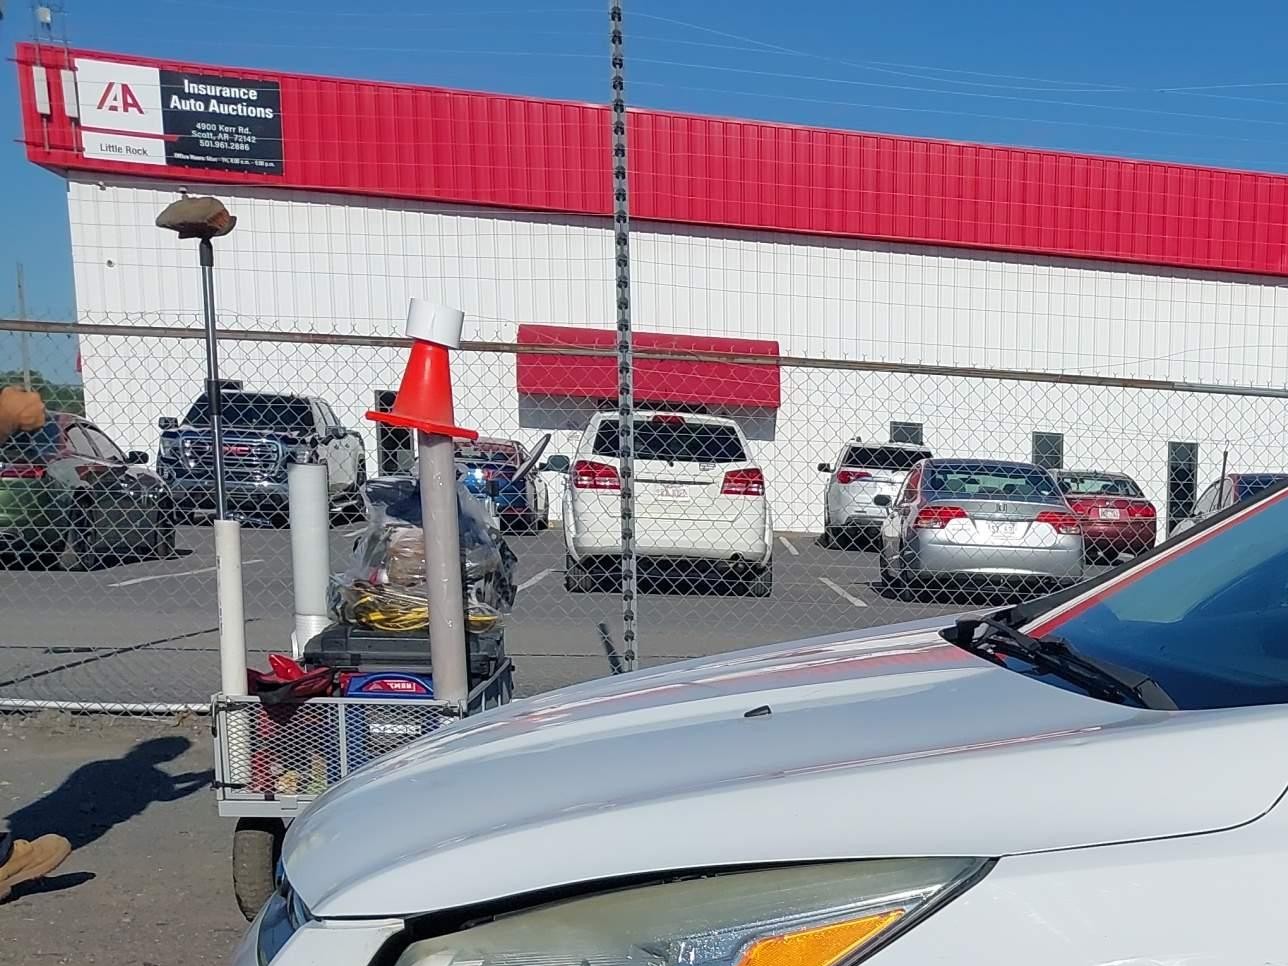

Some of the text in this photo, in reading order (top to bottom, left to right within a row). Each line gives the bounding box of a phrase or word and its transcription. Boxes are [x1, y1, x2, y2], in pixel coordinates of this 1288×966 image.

[184, 79, 258, 101] Insurance
[170, 95, 275, 119] Auto Auctions
[196, 122, 252, 135] 4900 Kerr Rd.
[191, 130, 257, 144] Scott, AR 72142
[100, 143, 150, 157] Little Rock
